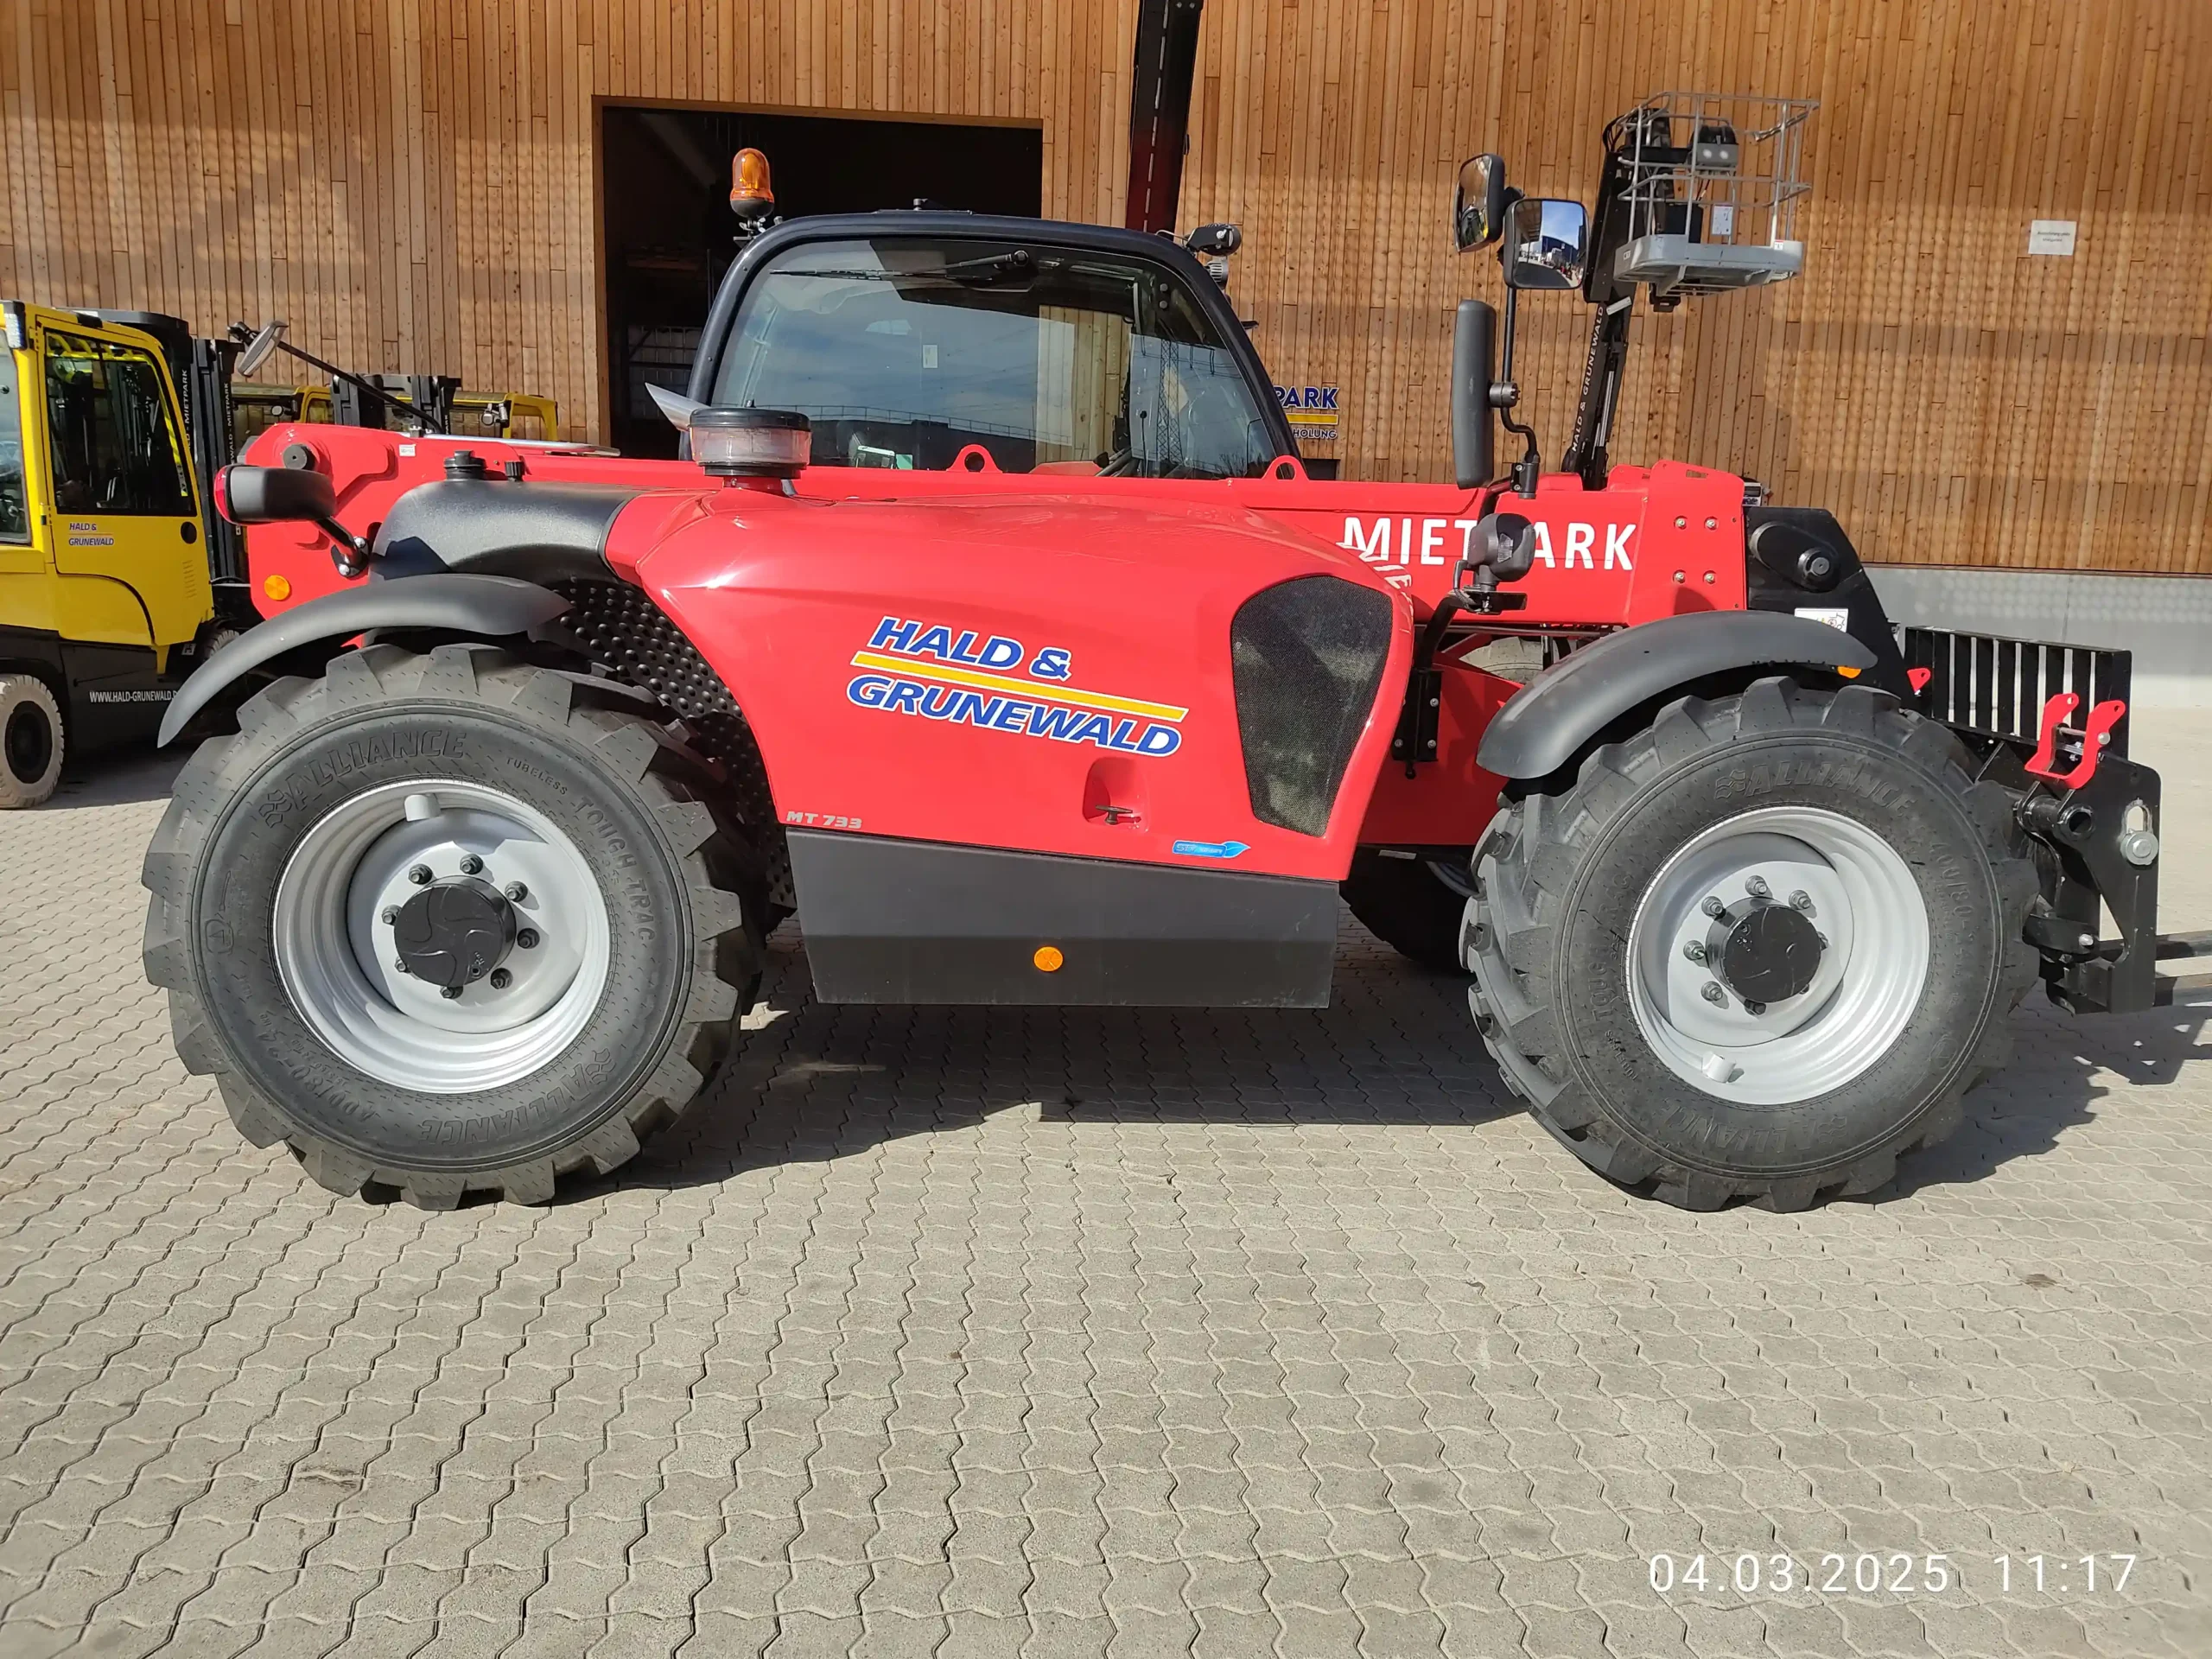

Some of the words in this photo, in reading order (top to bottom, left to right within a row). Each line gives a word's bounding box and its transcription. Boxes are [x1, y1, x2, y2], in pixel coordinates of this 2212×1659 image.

[1583, 305, 1605, 397] GRUNEWALD
[181, 369, 191, 424] MIETPARK
[223, 382, 233, 427] MIETPARK
[1580, 400, 1587, 412] &
[1571, 416, 1584, 452] HALD
[68, 537, 115, 547] GRUNEWALD
[69, 522, 91, 531] HALD
[92, 523, 98, 531] &
[1344, 517, 1637, 571] MIETARK
[867, 616, 1024, 670] HALD
[1029, 645, 1073, 682] &
[846, 673, 1183, 759] GRUNEWALD
[284, 729, 467, 812] ALLIANCE
[505, 756, 569, 796] TUBELESS
[1744, 760, 1918, 817] ALLIANCE
[786, 810, 819, 824] MT
[823, 814, 863, 830] 733
[573, 796, 638, 870] TOUGH
[627, 875, 656, 942] TRAC
[418, 1063, 592, 1147] ALLIANCE
